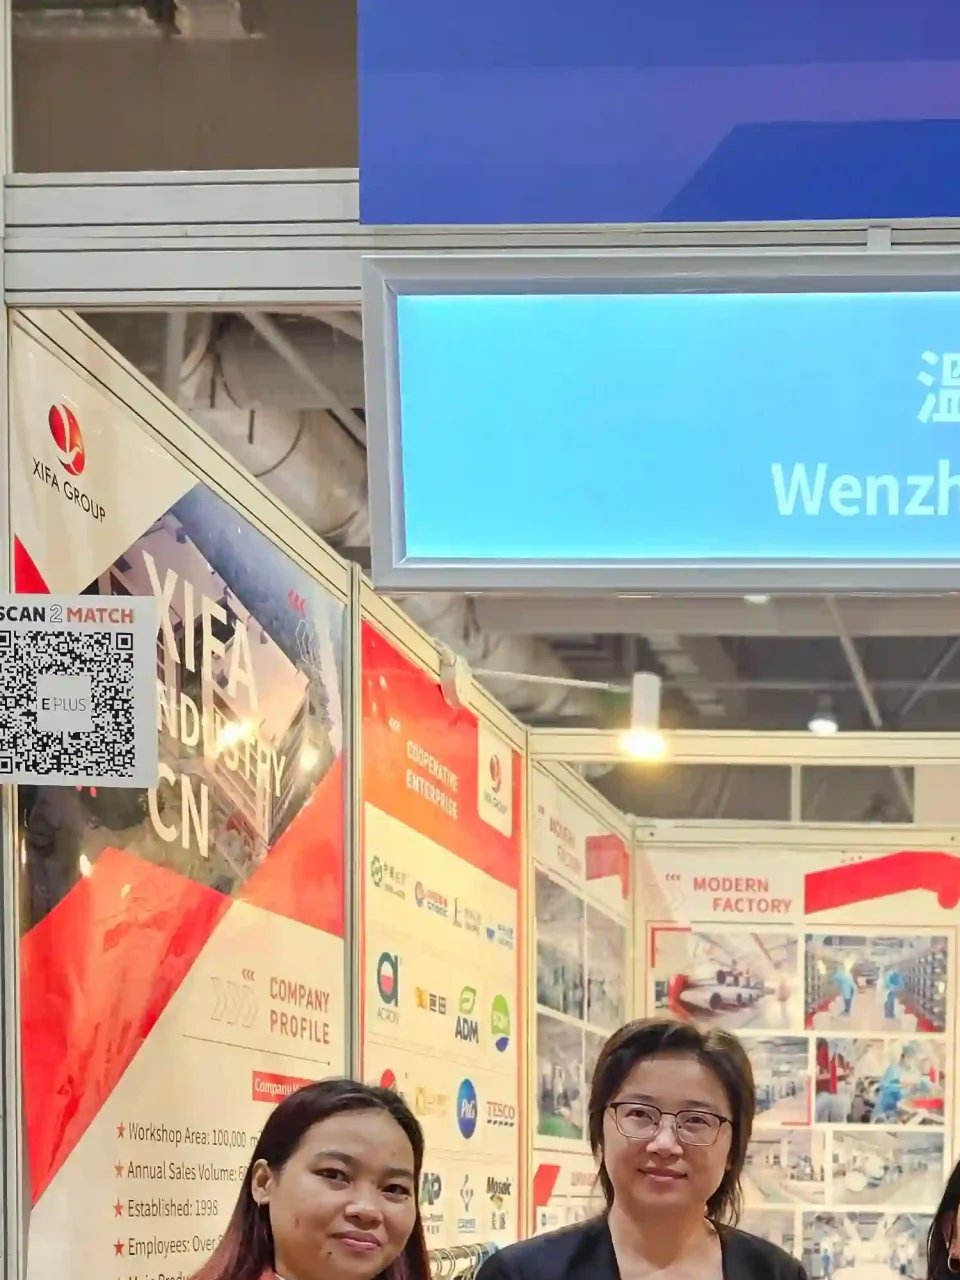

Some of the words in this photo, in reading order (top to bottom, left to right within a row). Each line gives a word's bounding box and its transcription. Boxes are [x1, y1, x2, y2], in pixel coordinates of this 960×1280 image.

[32, 456, 61, 493] XIFA
[63, 480, 106, 523] GROUP
[50, 604, 63, 623] 2
[66, 606, 135, 624] MATCH
[143, 551, 258, 716] XIFA
[406, 739, 459, 793] COOPERATIVE
[405, 768, 459, 821] ENTERPRISE
[148, 761, 210, 859] CN
[692, 876, 770, 894] MODERN
[711, 896, 793, 914] FACTORY
[269, 975, 331, 1014] COMPANY
[269, 1008, 331, 1045] PROFILE
[455, 1015, 479, 1044] ADM
[486, 1100, 515, 1120] TESCO
[128, 1121, 182, 1148] Workshop
[184, 1127, 210, 1146] Area:
[212, 1128, 247, 1150] 100,000
[127, 1161, 167, 1179] Annual
[168, 1162, 197, 1181] Sales
[198, 1163, 237, 1182] Volume:
[486, 1176, 512, 1197] Mosaic
[128, 1197, 193, 1218] Established:
[195, 1199, 219, 1217] 1998
[128, 1235, 190, 1260] Employees:
[192, 1235, 217, 1252] Over
